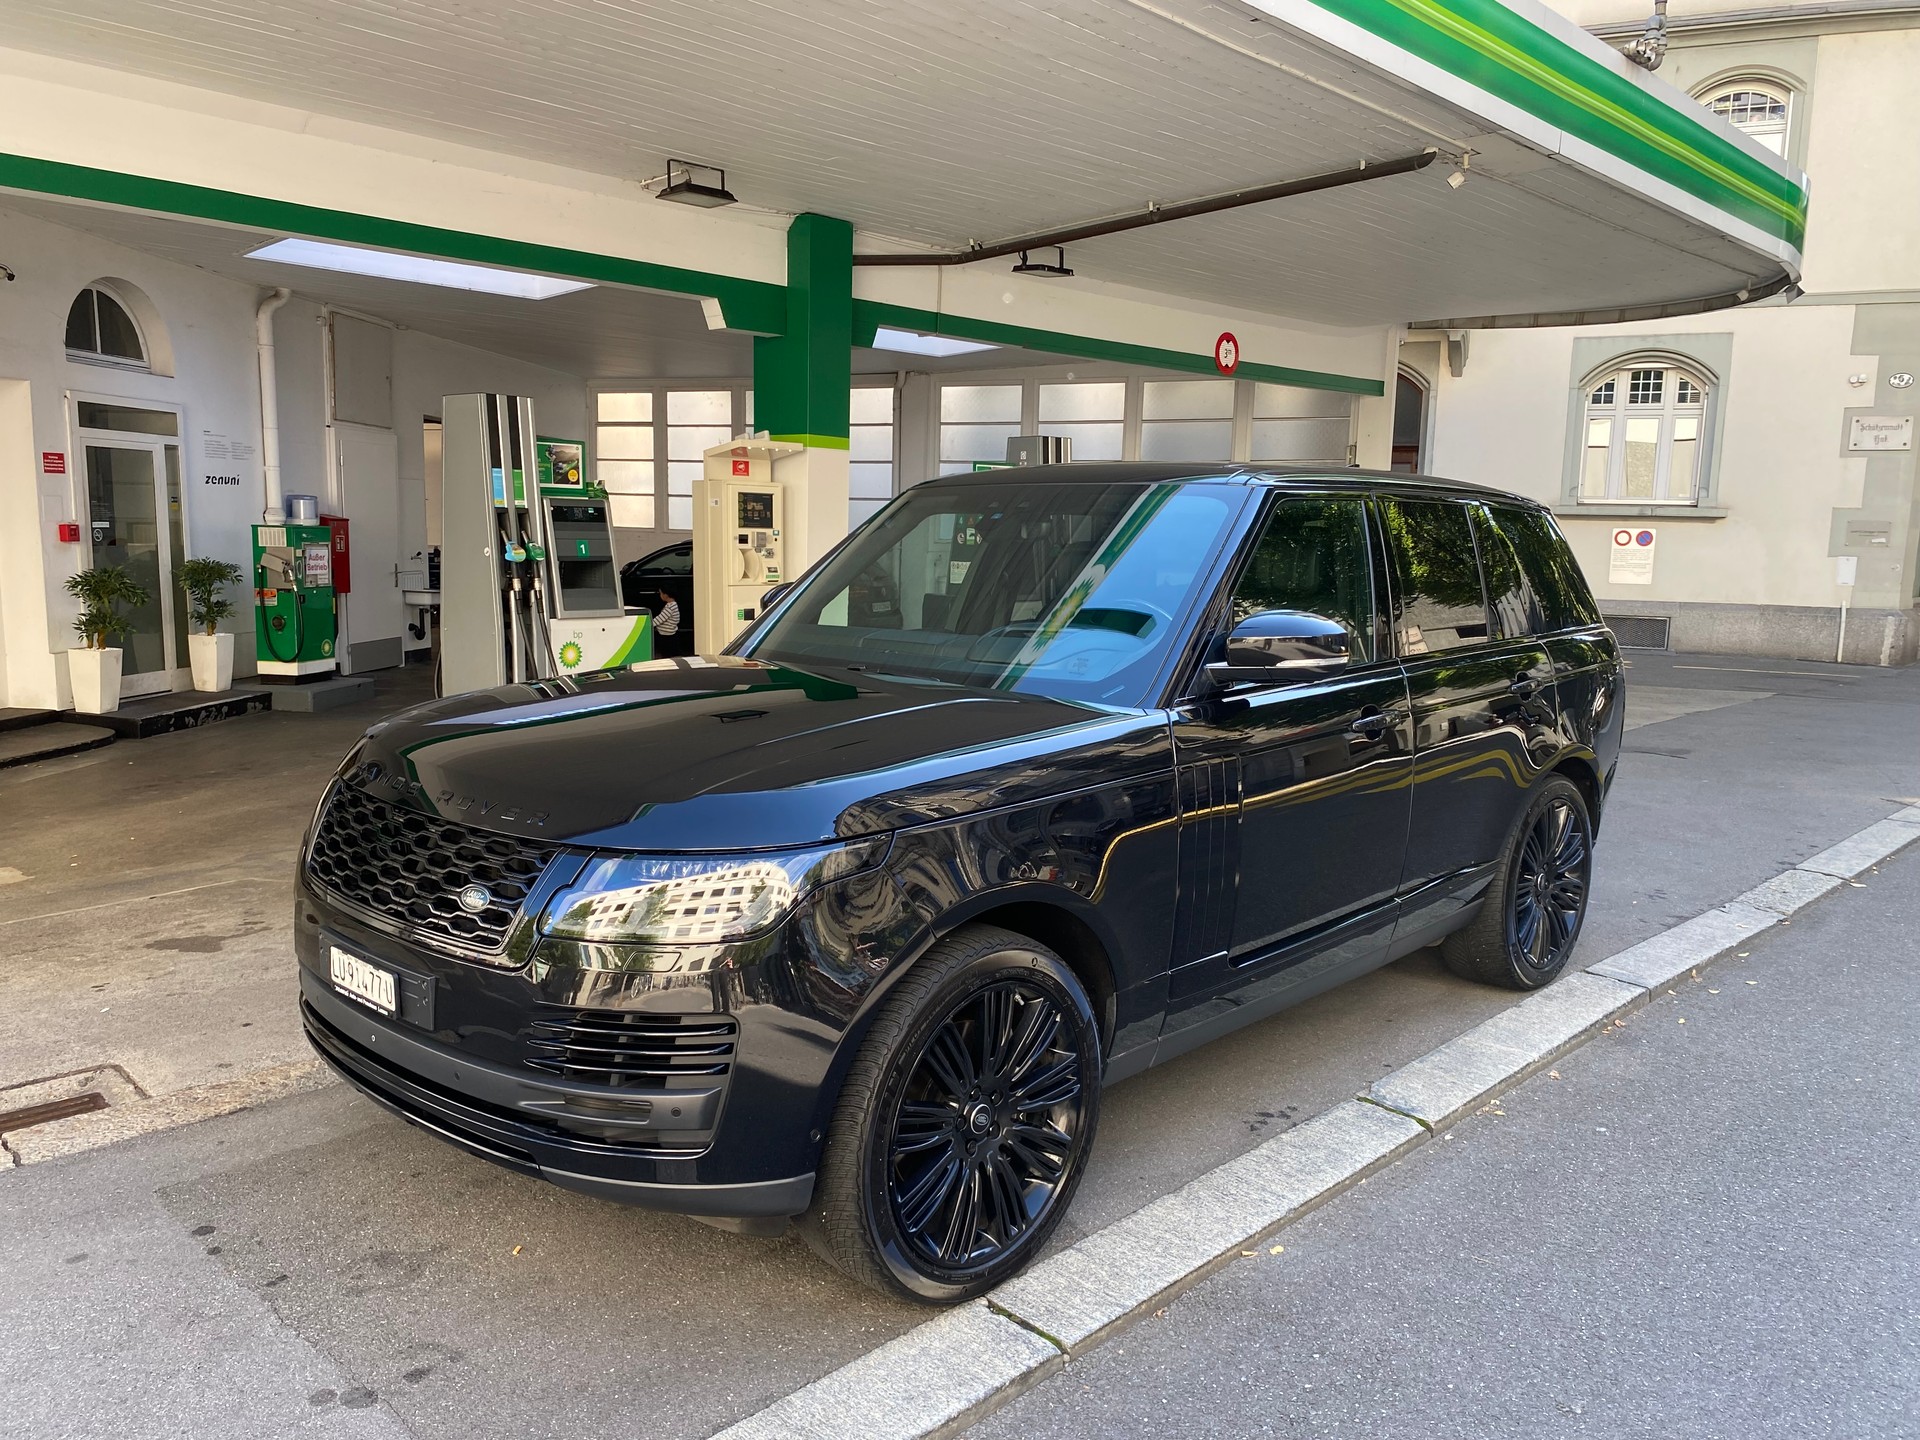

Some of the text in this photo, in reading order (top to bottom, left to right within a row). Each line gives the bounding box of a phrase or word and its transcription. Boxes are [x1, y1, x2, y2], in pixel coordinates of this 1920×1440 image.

[205, 474, 240, 486] zenuni
[580, 544, 586, 554] 1
[308, 553, 326, 562] Außer
[306, 563, 328, 571] Betrieb
[573, 631, 583, 639] bp
[357, 762, 550, 826] RANGE ROVER
